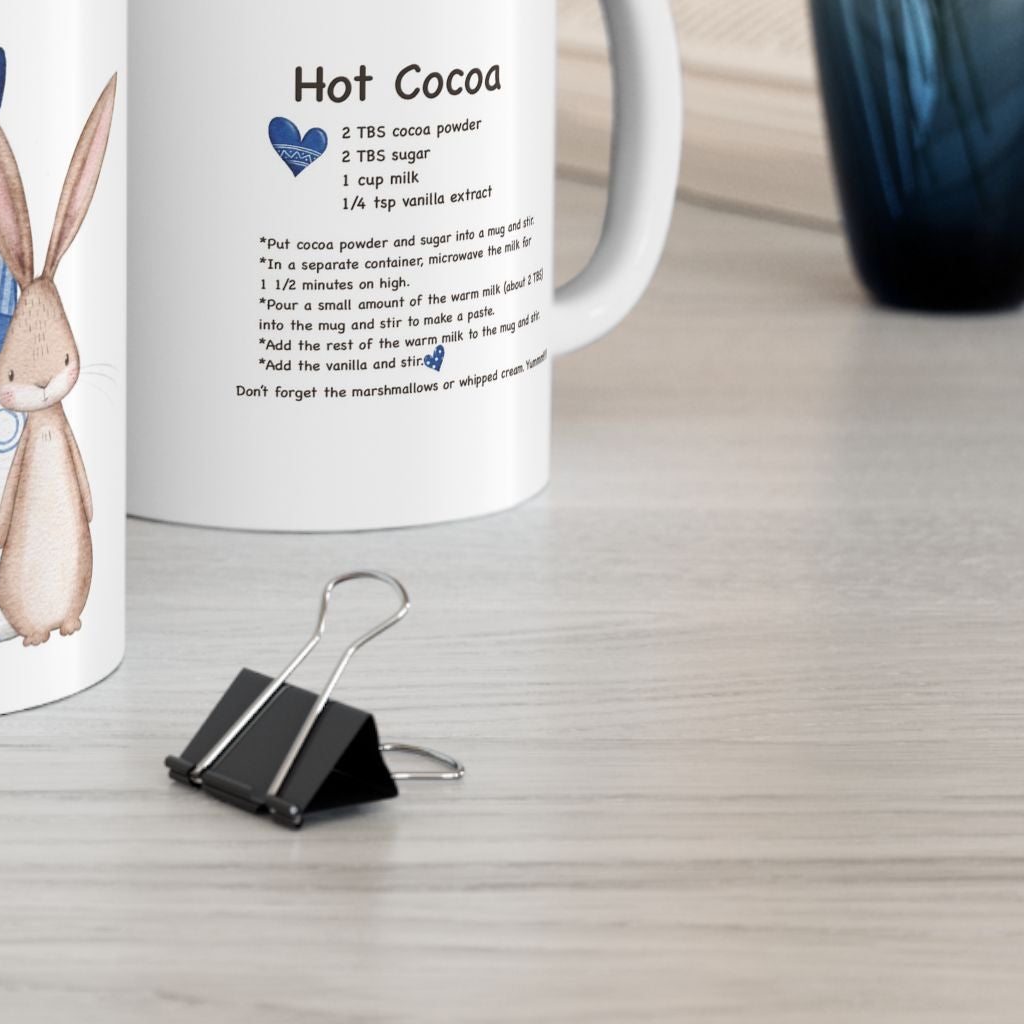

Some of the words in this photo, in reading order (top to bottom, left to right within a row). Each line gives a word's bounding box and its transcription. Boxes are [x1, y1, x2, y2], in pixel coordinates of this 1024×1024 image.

[294, 64, 374, 104] Hot
[394, 63, 502, 101] Cocoa
[341, 125, 352, 140] 2
[355, 125, 387, 140] TBS
[391, 124, 431, 138] cocoa
[436, 117, 483, 139] powder
[341, 149, 351, 164] 2
[355, 148, 386, 164] TBS
[391, 148, 432, 165] sugar
[343, 173, 350, 187] 1
[357, 175, 385, 191] cup
[389, 169, 420, 186] milk
[342, 194, 367, 212] 1/4
[373, 195, 397, 213] tsp
[401, 191, 445, 208] vanilla
[449, 184, 493, 204] extract
[296, 240, 335, 251] cocoa
[339, 236, 389, 254] powder
[392, 234, 416, 248] and
[419, 233, 453, 249] sugar
[455, 228, 476, 242] into
[478, 228, 485, 239] a
[487, 225, 506, 239] mug
[507, 218, 522, 233] and
[287, 261, 296, 271] a
[301, 257, 360, 275] separate
[364, 255, 425, 270] container,
[428, 249, 484, 265] microwave
[487, 244, 503, 257] the
[504, 238, 521, 254] milk
[260, 278, 267, 291] 1
[275, 277, 297, 292] 1/2
[301, 278, 354, 291] minutes
[358, 280, 375, 291] on
[379, 275, 411, 292] high.
[303, 301, 313, 312] a
[317, 298, 352, 311] small
[357, 295, 406, 311] amount
[409, 293, 424, 308] of
[427, 292, 447, 306] the
[450, 289, 480, 303] warm
[482, 283, 501, 299] milk
[503, 276, 527, 295] (about
[258, 318, 285, 332] into
[289, 319, 314, 332] the
[317, 321, 346, 335] mug
[350, 317, 375, 331] and
[379, 316, 403, 330] stir
[407, 315, 420, 328] to
[423, 311, 453, 326] make
[456, 312, 464, 323] a
[467, 305, 495, 324] paste.
[297, 339, 321, 352] the
[326, 338, 355, 352] rest
[358, 337, 374, 351] of
[378, 337, 401, 350] the
[404, 335, 438, 348] warm
[441, 329, 464, 344] milk
[468, 327, 479, 341] to
[481, 324, 498, 338] the
[499, 321, 516, 335] mug
[297, 359, 321, 372] the
[325, 358, 368, 372] vanilla
[372, 356, 397, 371] and
[400, 354, 423, 369] stir.
[274, 385, 318, 402] forget
[323, 386, 348, 399] the
[351, 381, 439, 398] marshmallows
[442, 379, 456, 391] or
[458, 370, 498, 389] whipped
[500, 364, 525, 380] cream.
